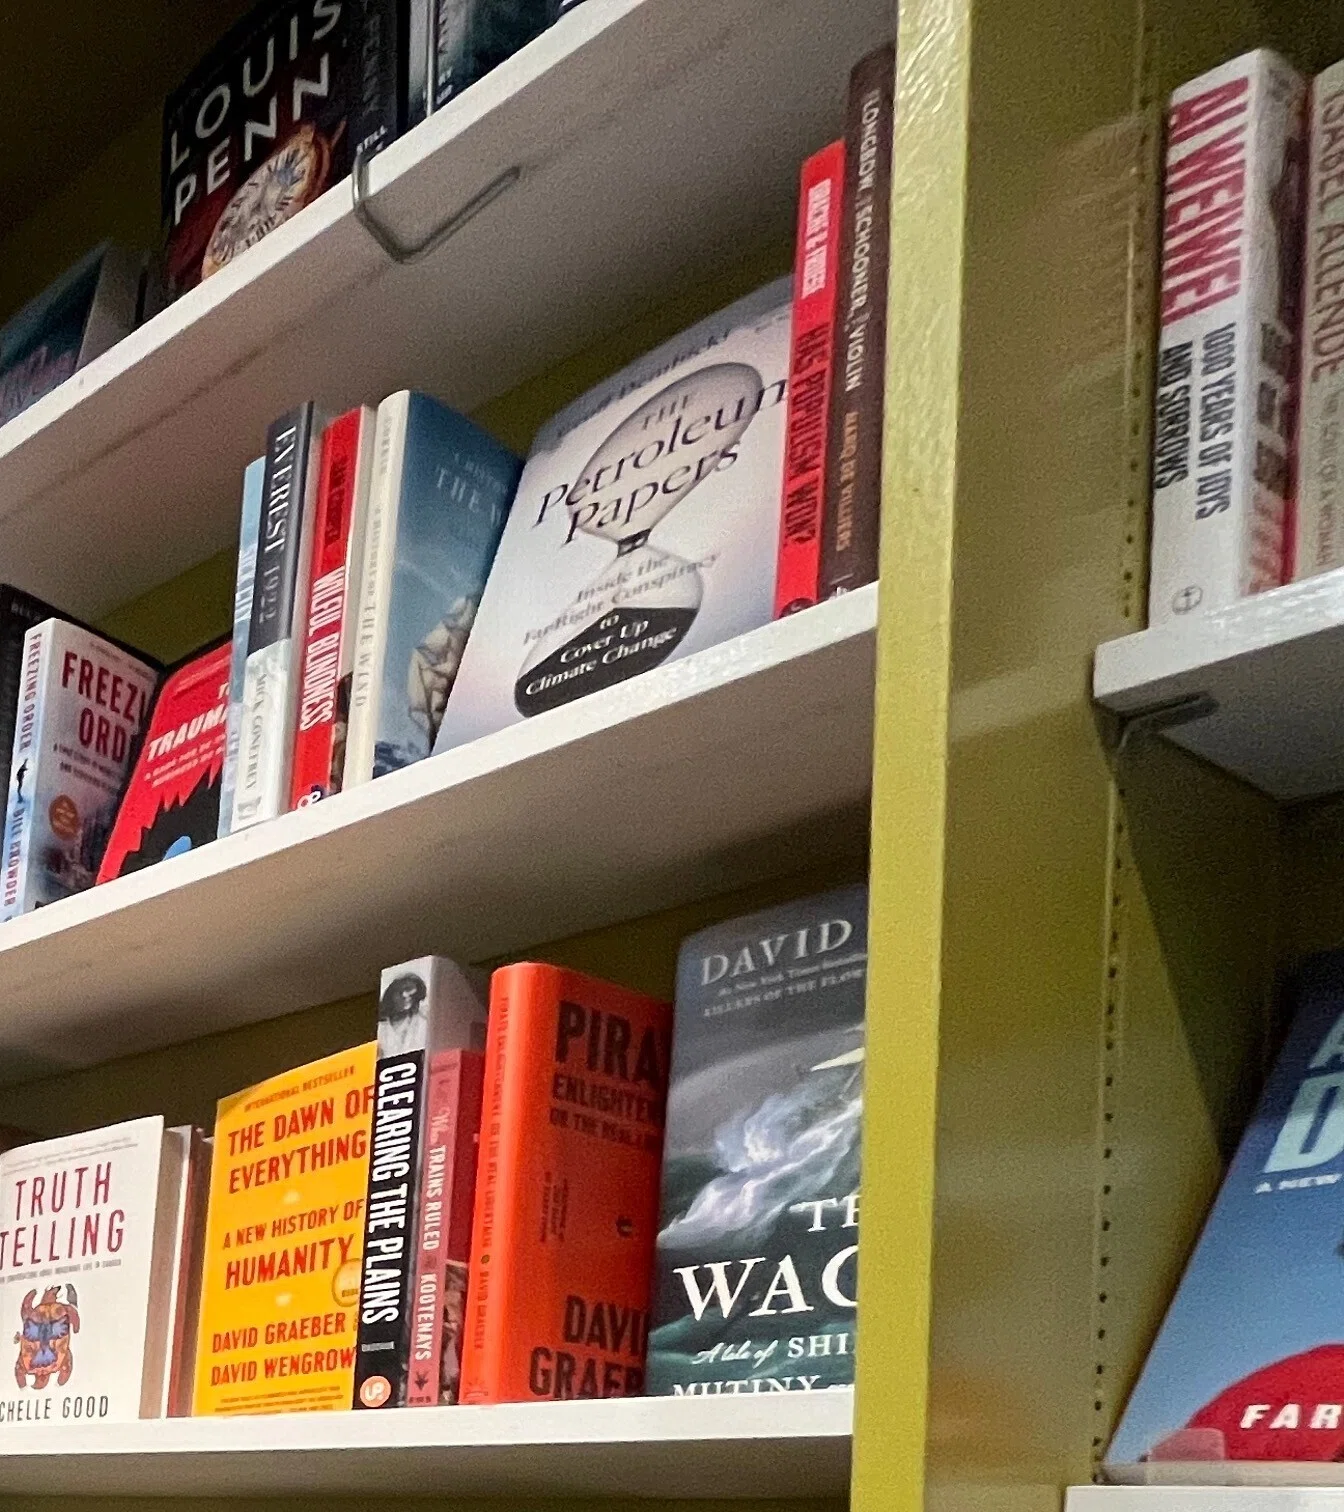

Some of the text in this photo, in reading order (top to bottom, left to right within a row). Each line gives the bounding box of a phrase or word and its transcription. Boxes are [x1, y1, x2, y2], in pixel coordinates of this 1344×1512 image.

[1155, 341, 1192, 492] AND SORROWS
[1196, 322, 1235, 523] 1000 YEARS OF JOYS
[558, 444, 742, 546] Papers
[228, 1084, 374, 1156] THE DAWN OF
[14, 1160, 111, 1221] TRUTH
[228, 1130, 368, 1194] EVERYTHING
[360, 1061, 417, 1325] CLEARING THE PLAINS
[0, 1209, 125, 1269] TELLING
[223, 1199, 363, 1249] A NEW HISTORY OF
[225, 1233, 355, 1289] HUMANITY
[211, 1314, 345, 1354] DAVID GRAEBER
[210, 1347, 356, 1386] DAVID WENGROW
[63, 1394, 109, 1418] GOOD
